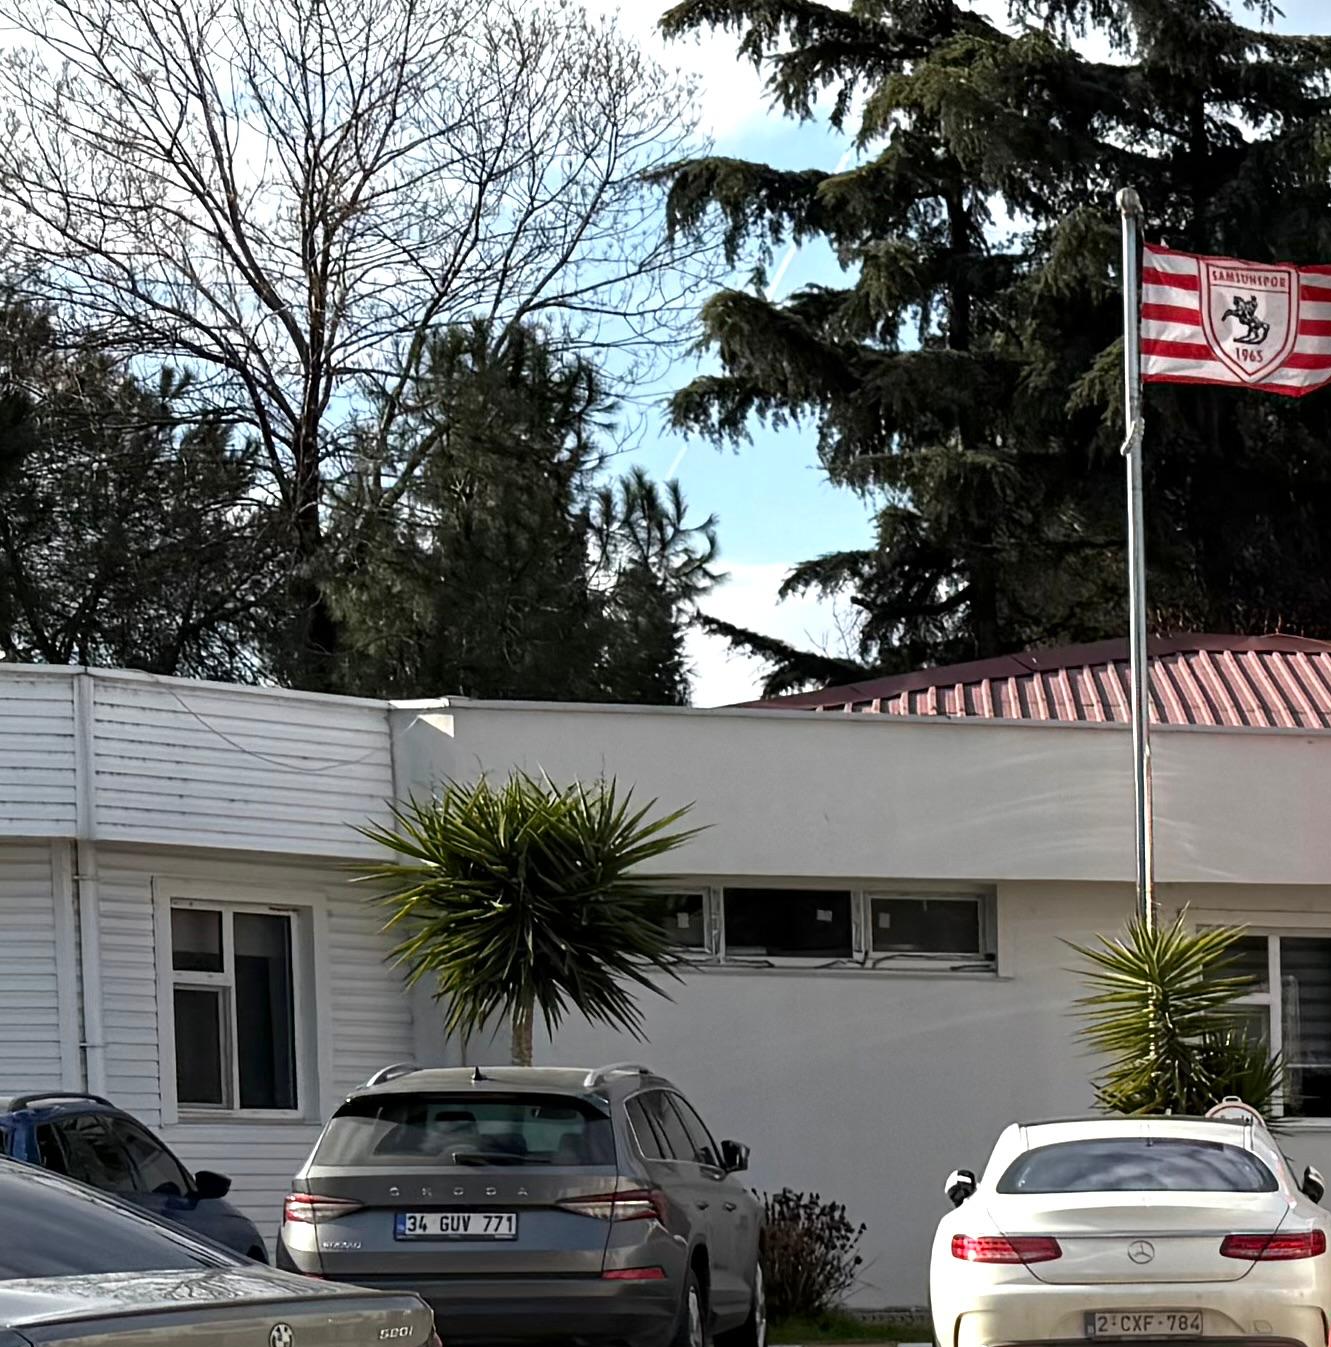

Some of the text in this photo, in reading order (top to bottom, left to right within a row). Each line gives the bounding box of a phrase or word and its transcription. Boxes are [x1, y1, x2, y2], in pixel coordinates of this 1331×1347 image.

[1212, 270, 1287, 288] SAMSUNSPOR
[1235, 347, 1264, 363] 1965
[407, 1215, 513, 1232] 34 GUV 771
